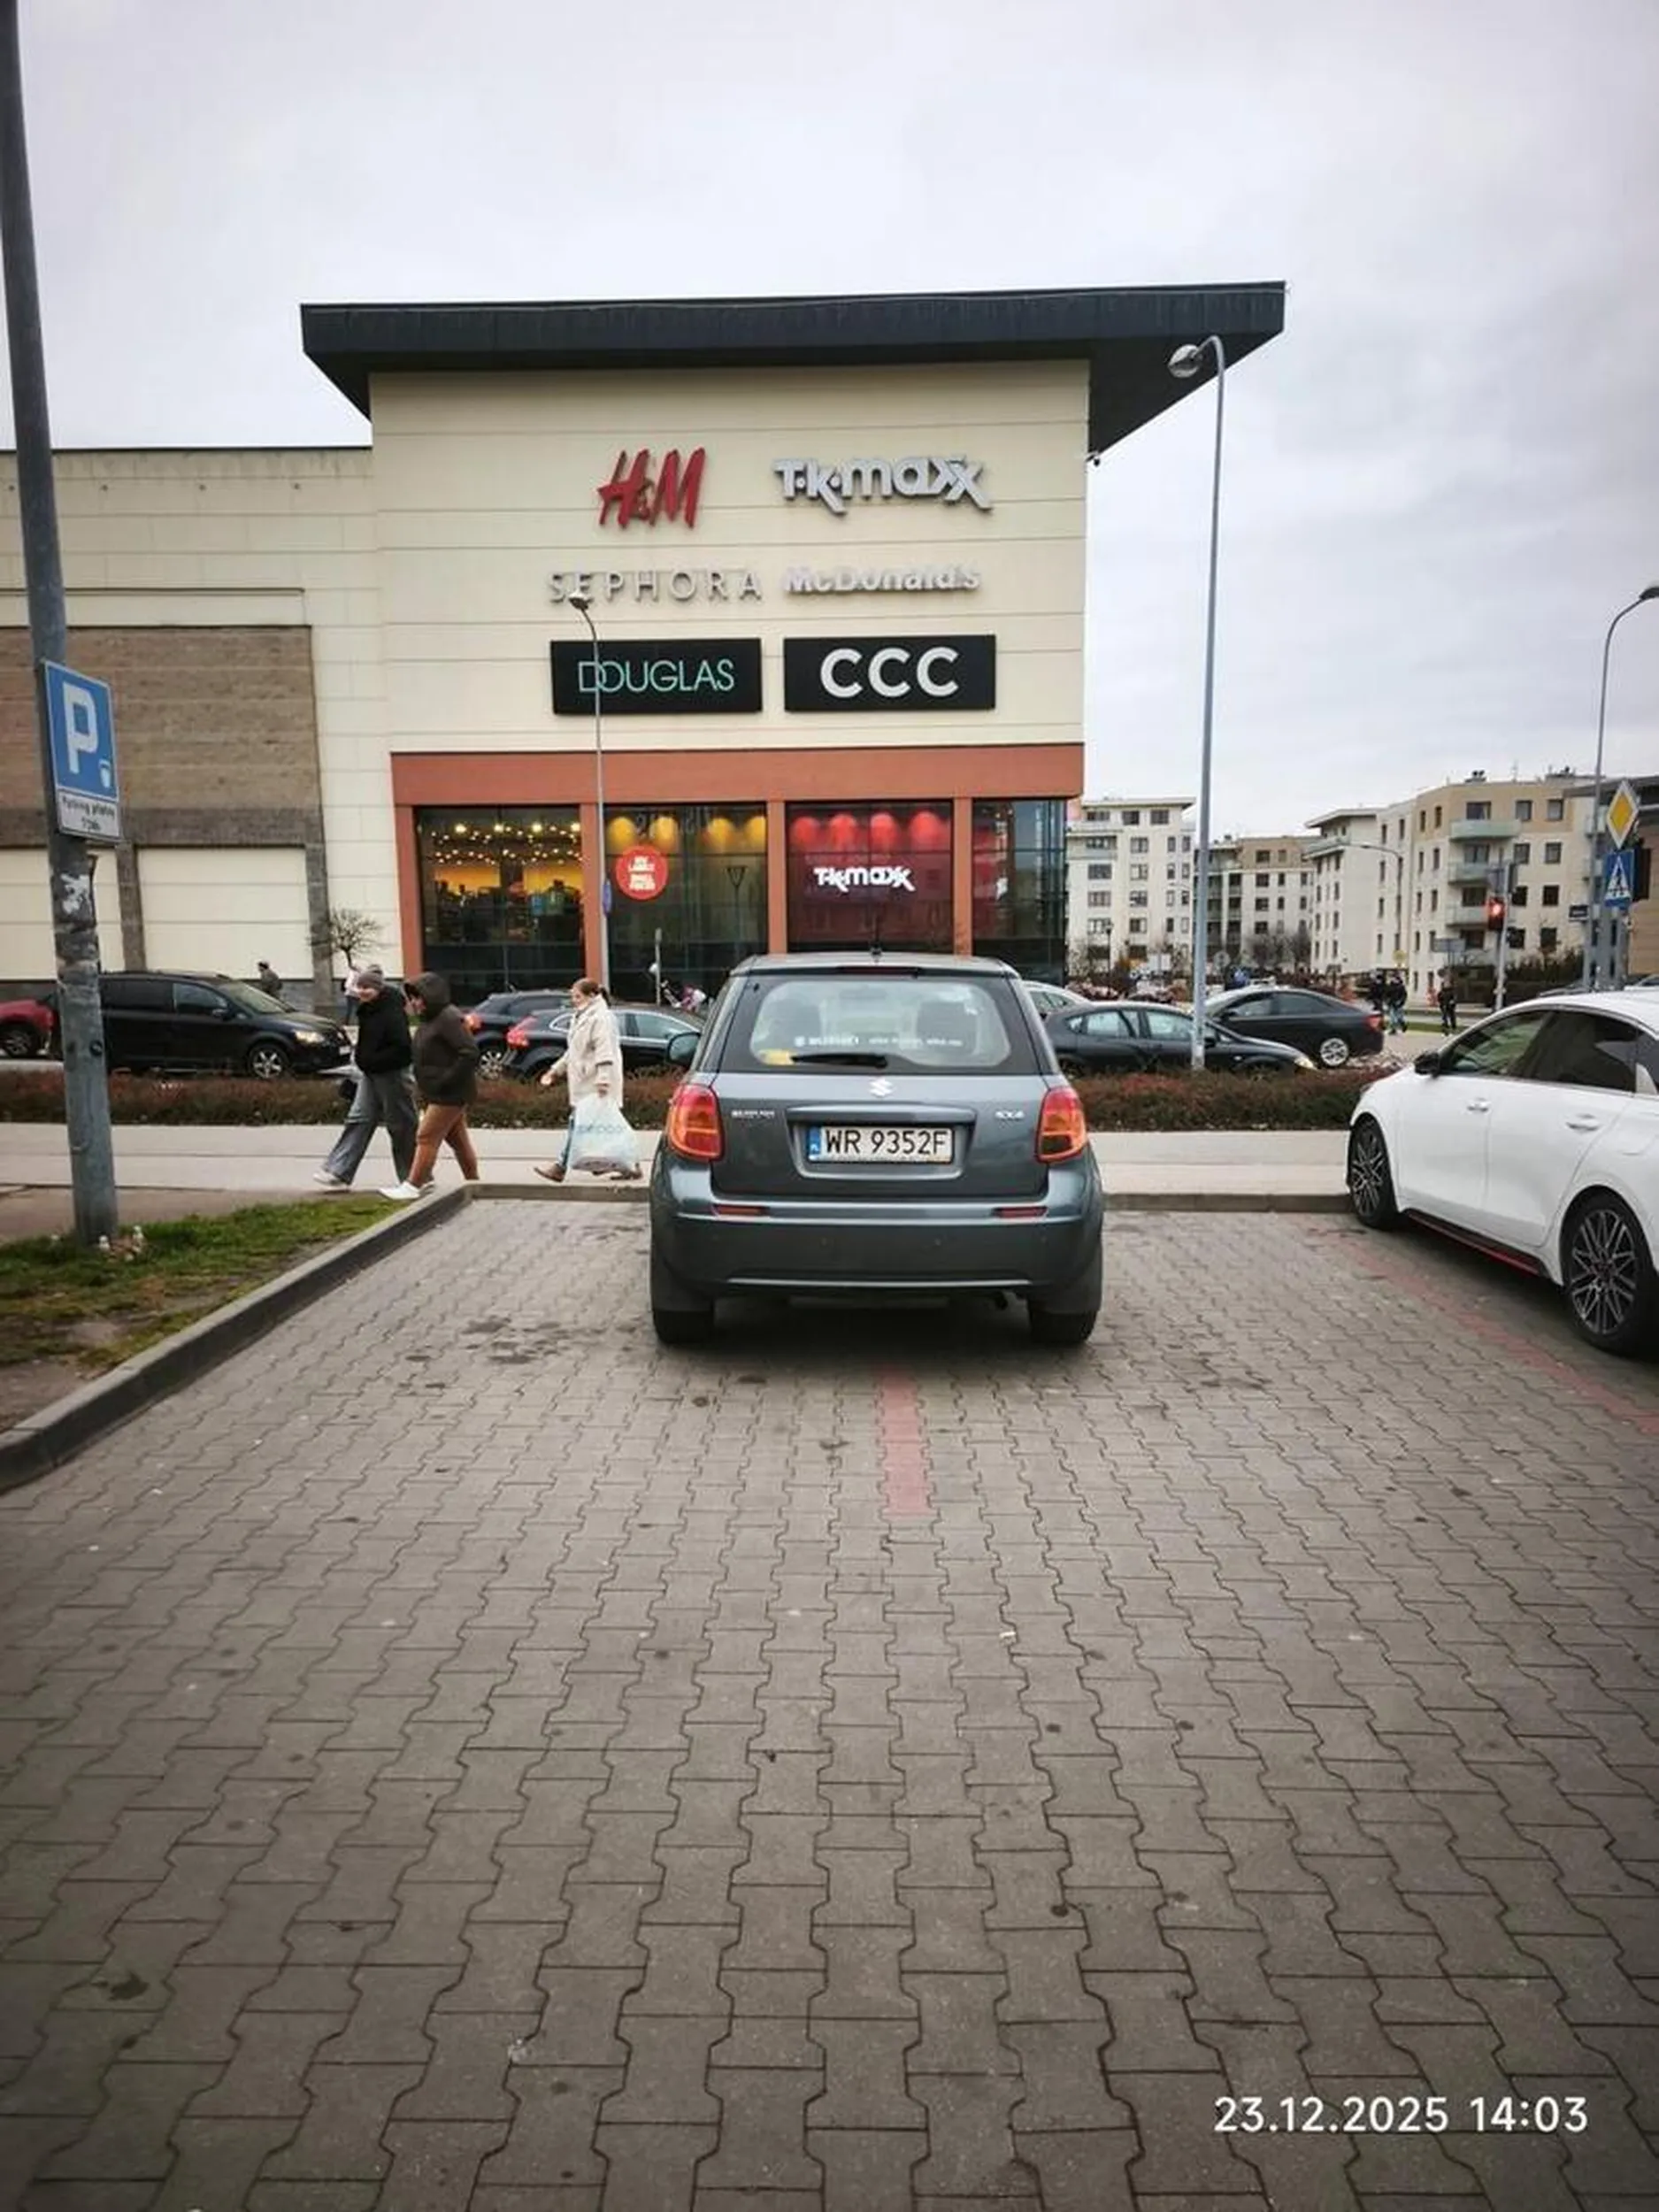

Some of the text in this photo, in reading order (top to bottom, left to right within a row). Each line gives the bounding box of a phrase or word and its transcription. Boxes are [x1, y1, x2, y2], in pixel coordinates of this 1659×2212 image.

[596, 447, 705, 529] H&M
[550, 571, 762, 603] SEPHORA
[784, 566, 980, 593] McDonald's
[578, 658, 735, 693] DOUGLAS
[820, 647, 959, 698] CCC
[62, 681, 98, 775] P
[826, 1130, 948, 1155] WR 9352F
